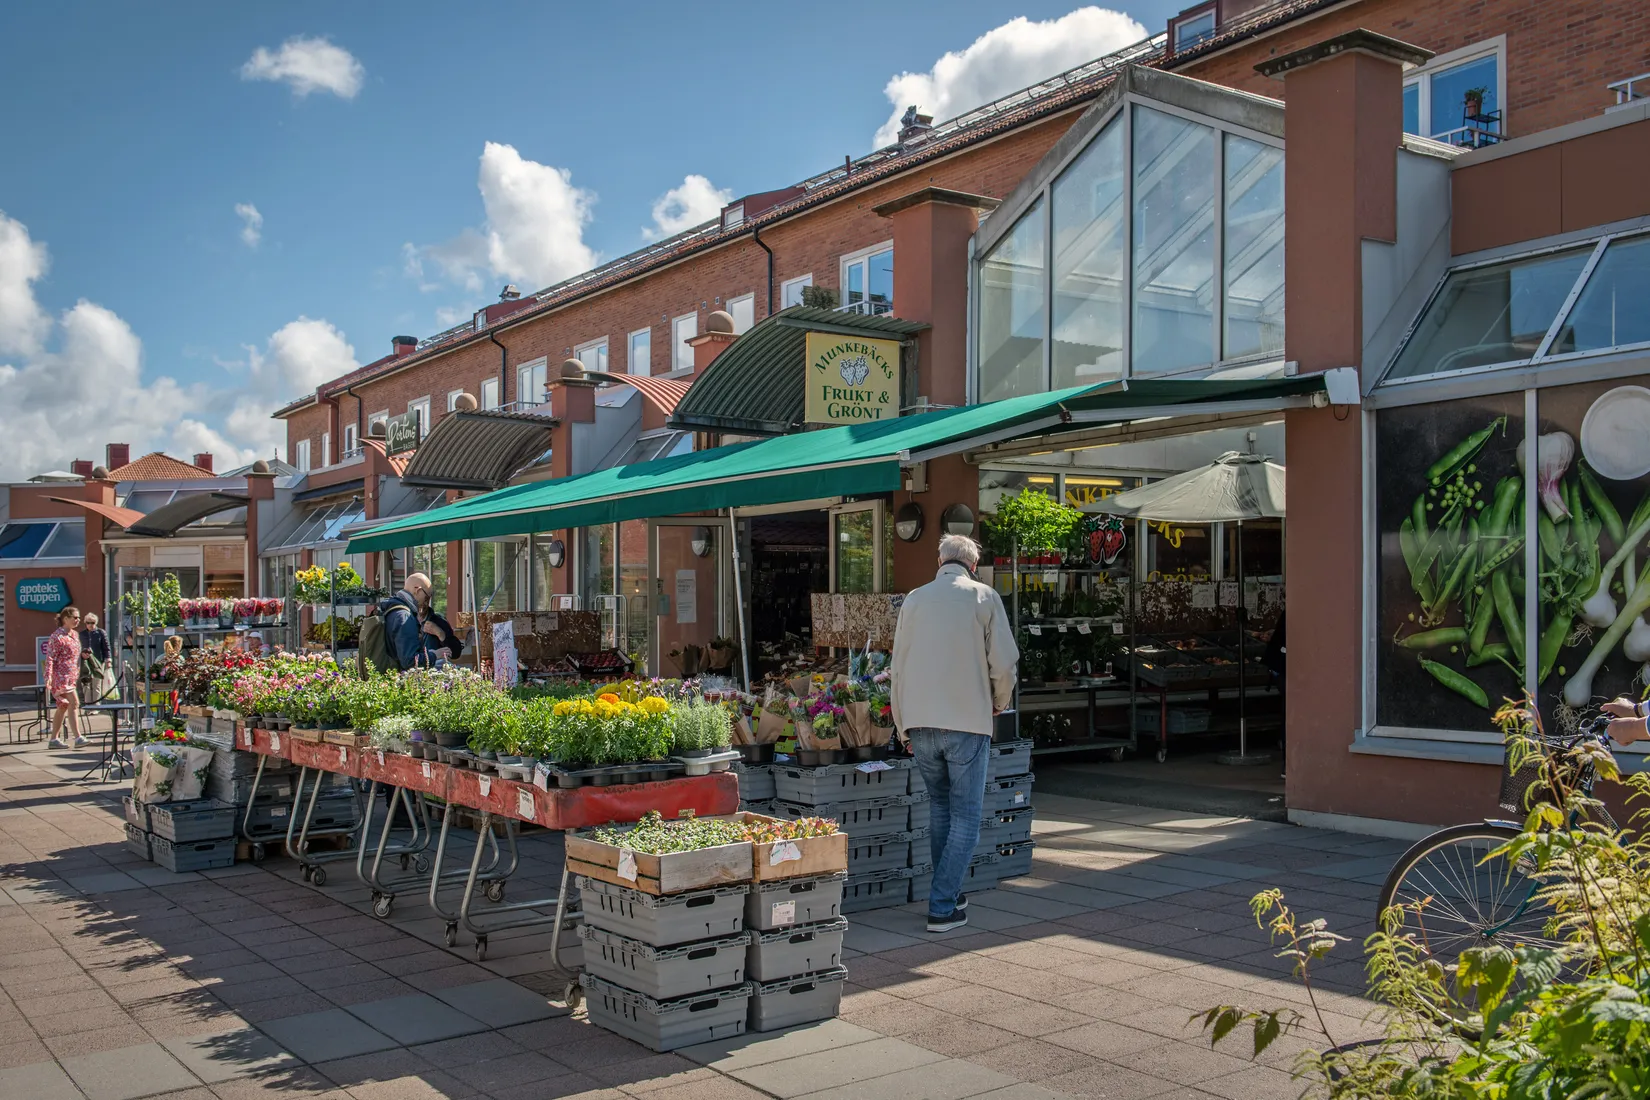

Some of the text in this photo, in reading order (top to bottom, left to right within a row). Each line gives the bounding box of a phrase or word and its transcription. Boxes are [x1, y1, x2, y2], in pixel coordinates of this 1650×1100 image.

[822, 385, 890, 404] FRUKT &
[827, 402, 883, 419] GRÖNT
[20, 583, 58, 595] apoteks
[20, 593, 61, 605] gruppen
